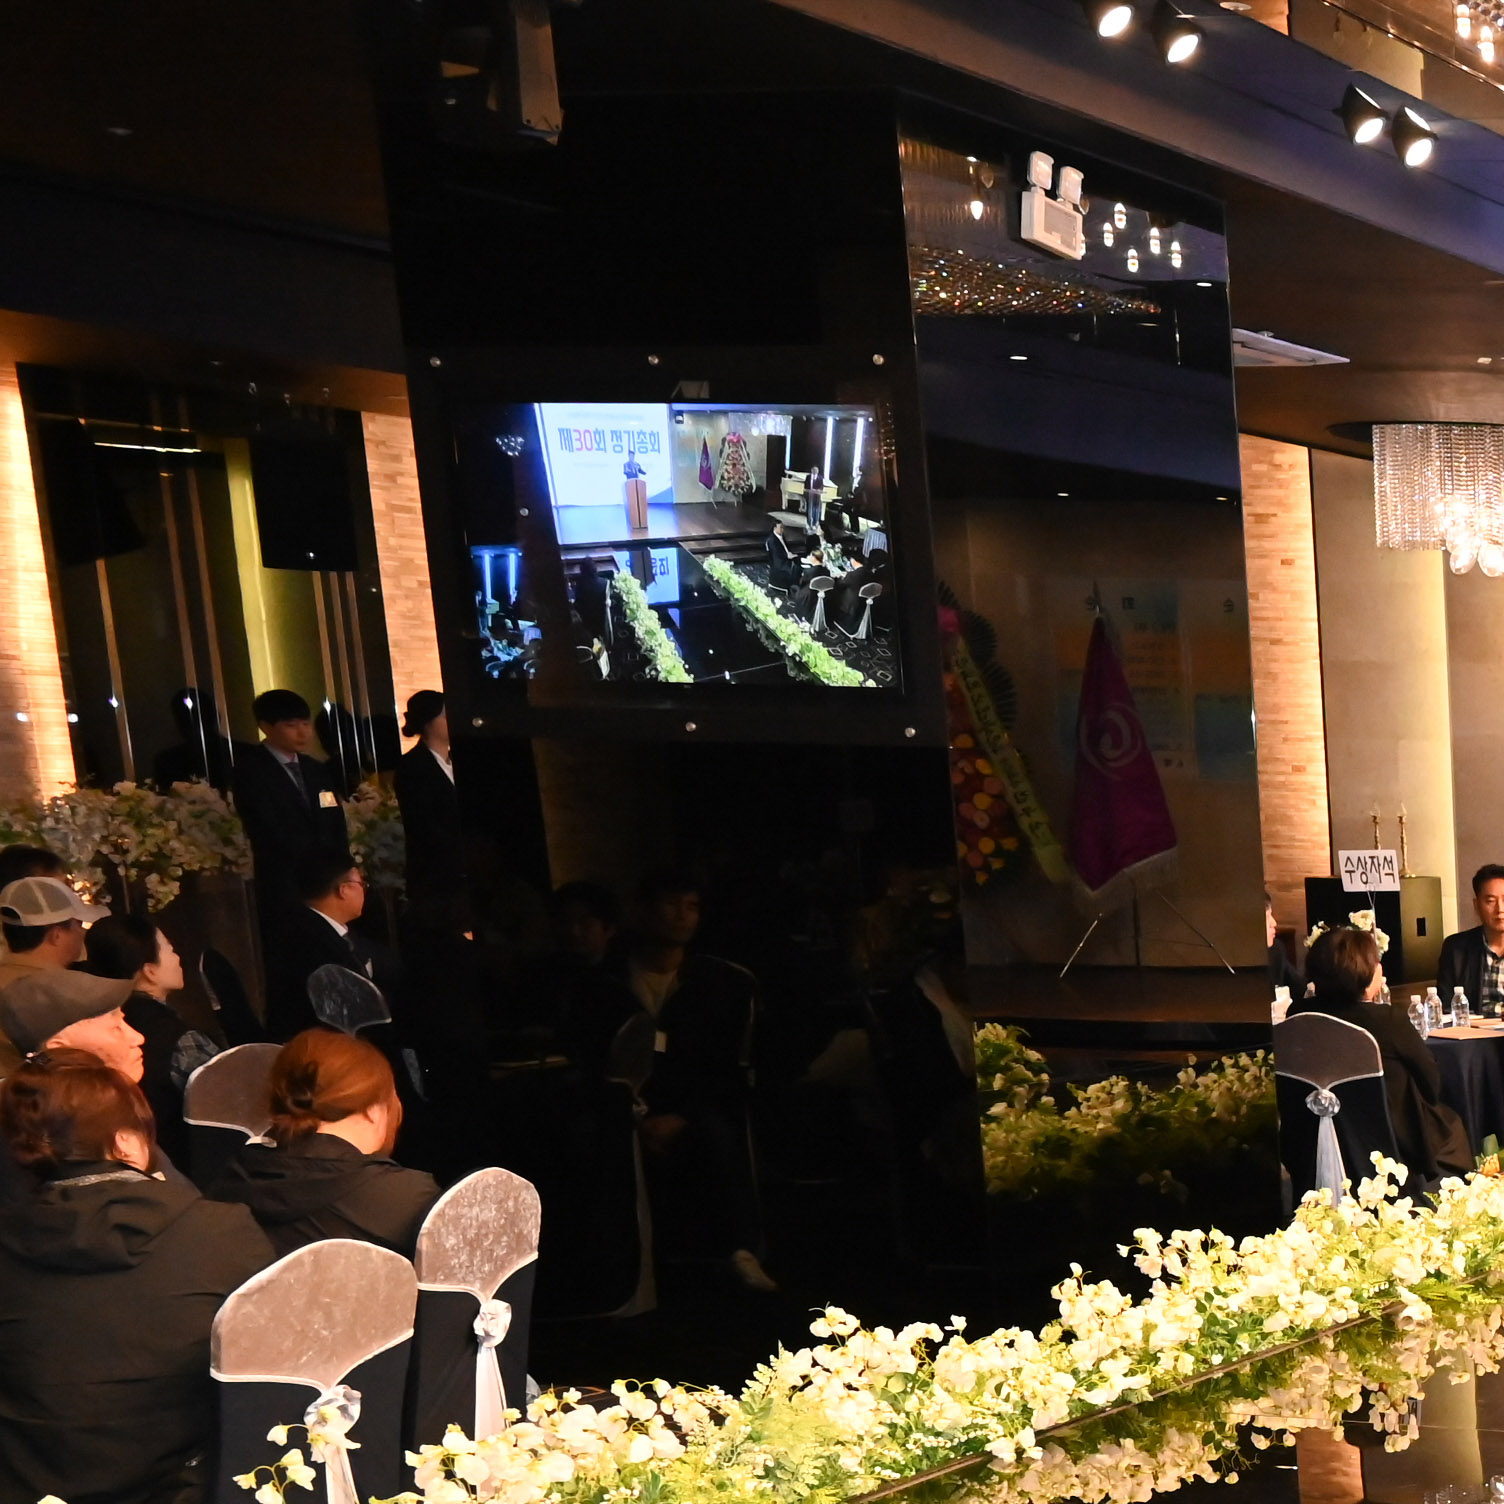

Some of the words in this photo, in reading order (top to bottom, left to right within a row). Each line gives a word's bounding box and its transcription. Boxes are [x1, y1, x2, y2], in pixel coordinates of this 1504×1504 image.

[557, 427, 607, 453] 제30회
[610, 429, 661, 455] 정기총회
[1344, 855, 1396, 885] 수상자석
